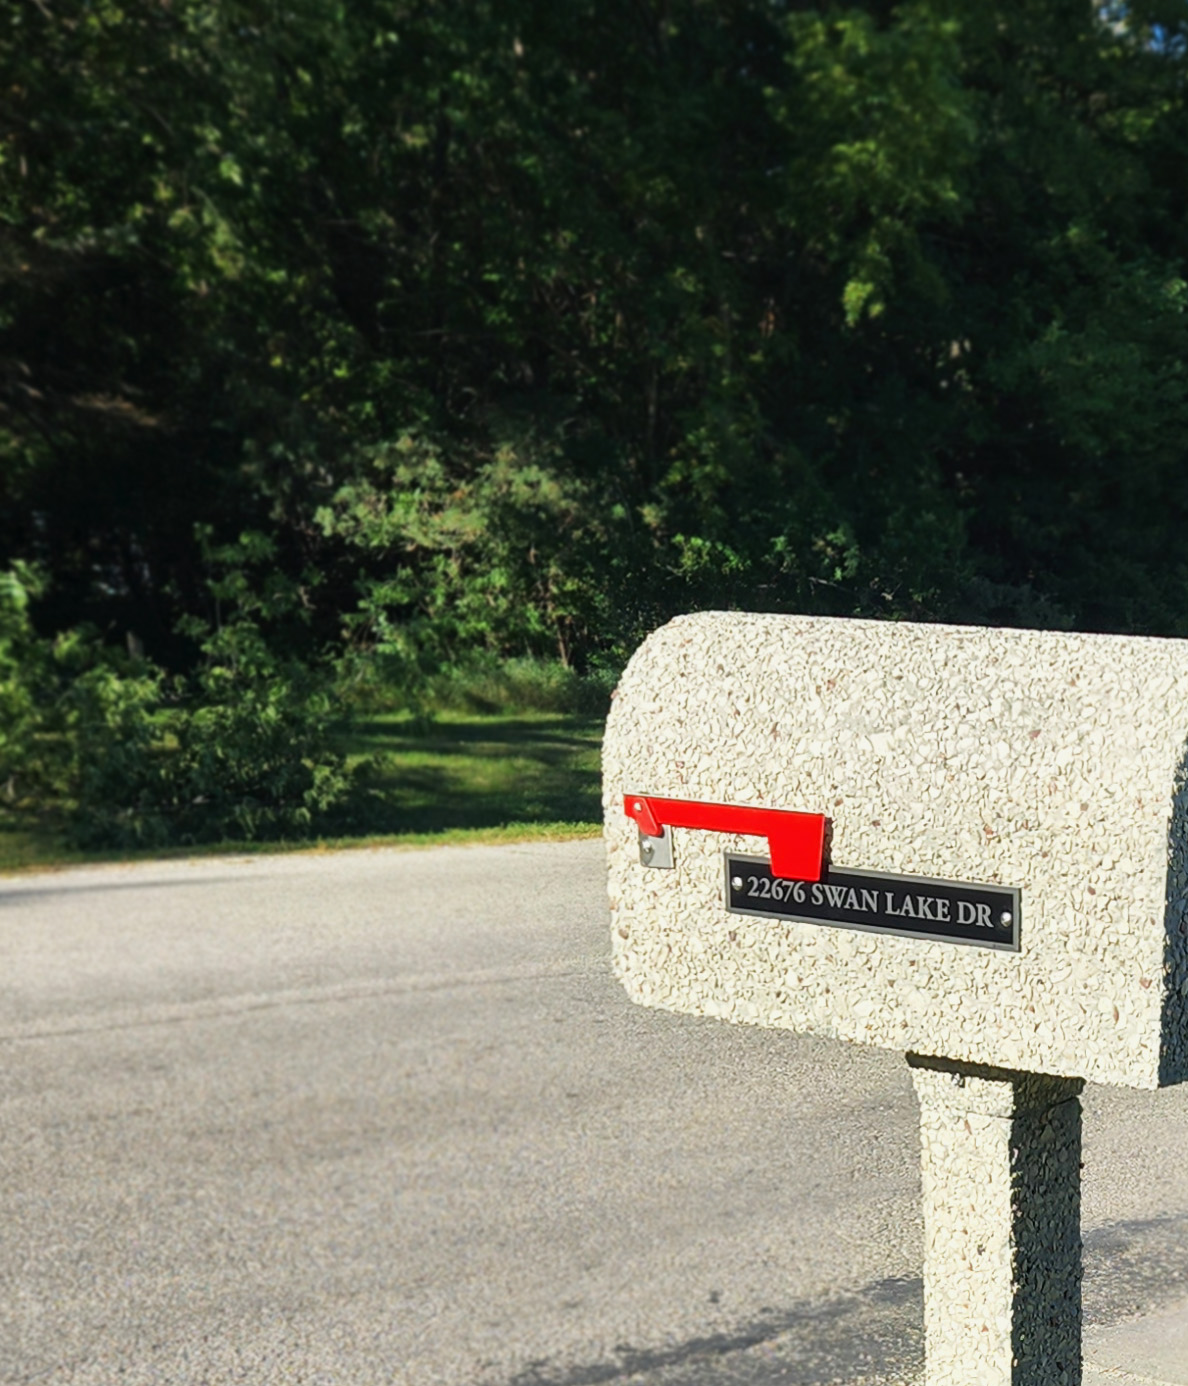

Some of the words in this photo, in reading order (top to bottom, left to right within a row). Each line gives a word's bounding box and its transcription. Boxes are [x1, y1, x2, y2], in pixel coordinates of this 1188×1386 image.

[747, 876, 806, 903] 22676
[811, 883, 879, 913] SWAN
[885, 892, 951, 922] LAKE
[956, 901, 995, 928] DR
